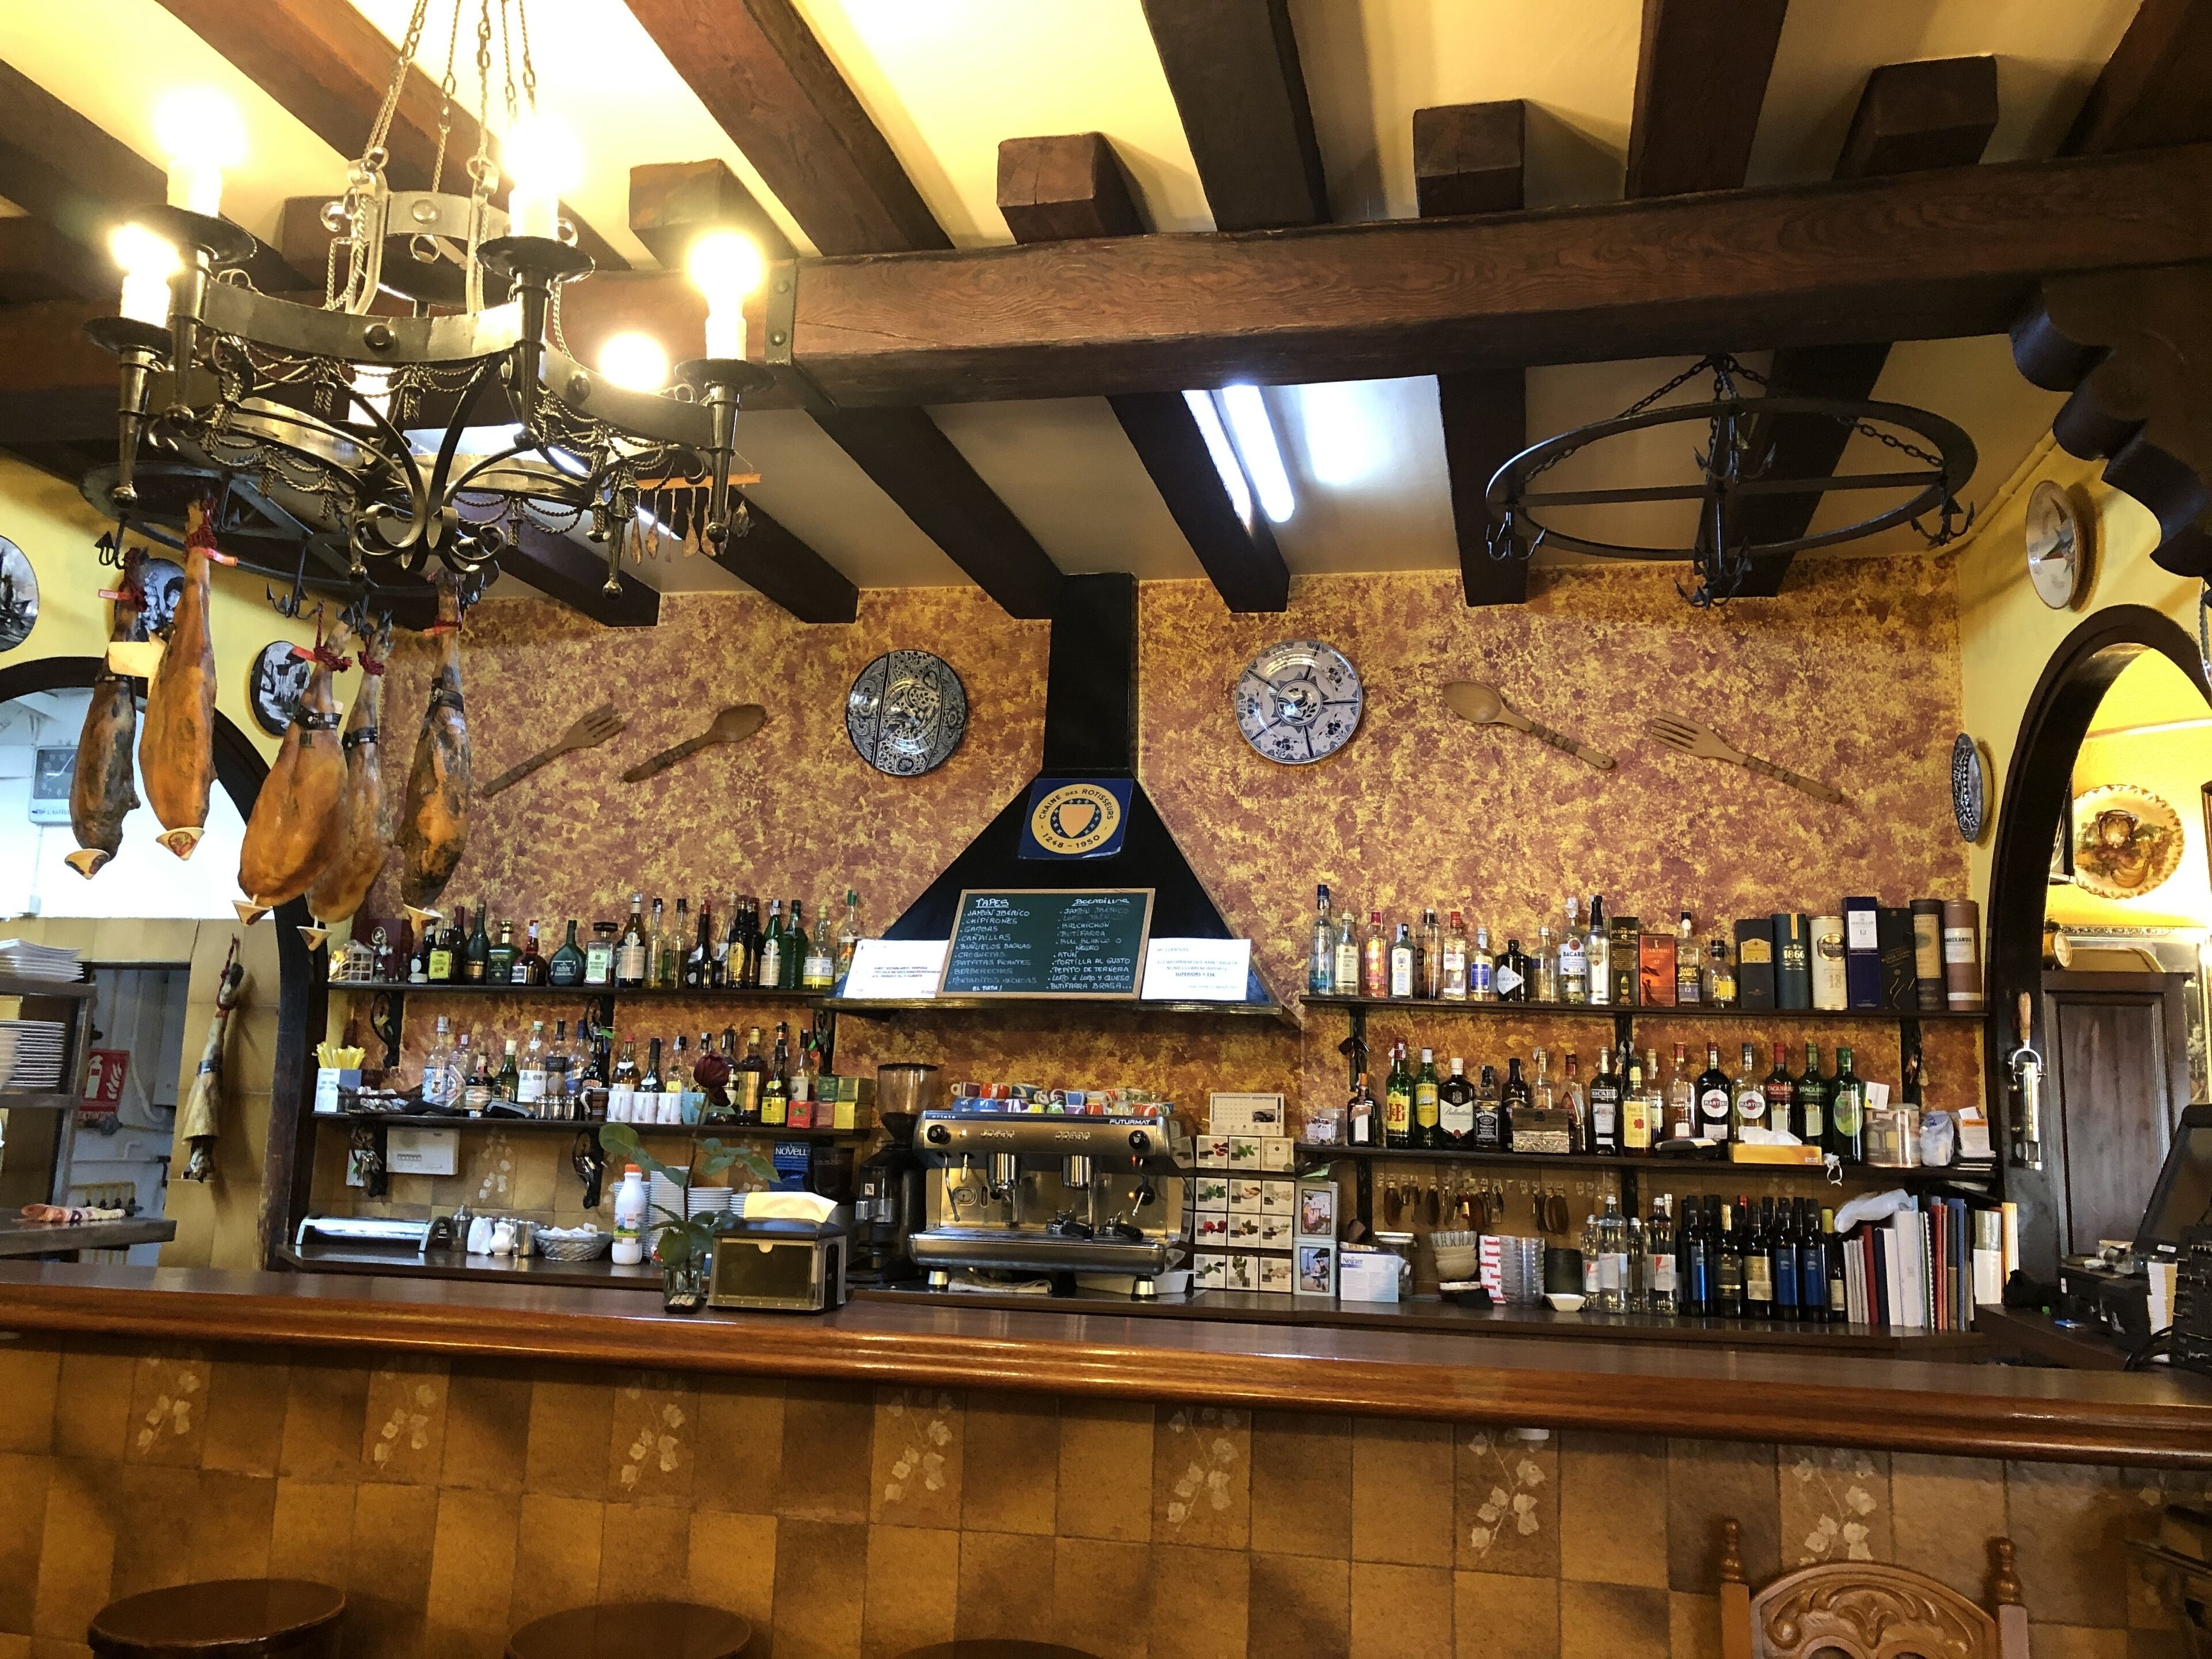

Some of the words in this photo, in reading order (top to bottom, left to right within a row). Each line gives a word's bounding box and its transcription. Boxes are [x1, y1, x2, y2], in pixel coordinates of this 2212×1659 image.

[1039, 794, 1061, 819] CHAINE
[1082, 789, 1113, 820] ROTISSEURS
[1043, 833, 1064, 849] 1248
[1076, 835, 1100, 849] 1950
[976, 898, 1010, 907] TAPES
[1054, 957, 1092, 965] TORTILLA
[1783, 949, 1805, 959] 1866
[1829, 974, 1842, 988] 18
[1387, 1103, 1405, 1122] J&B
